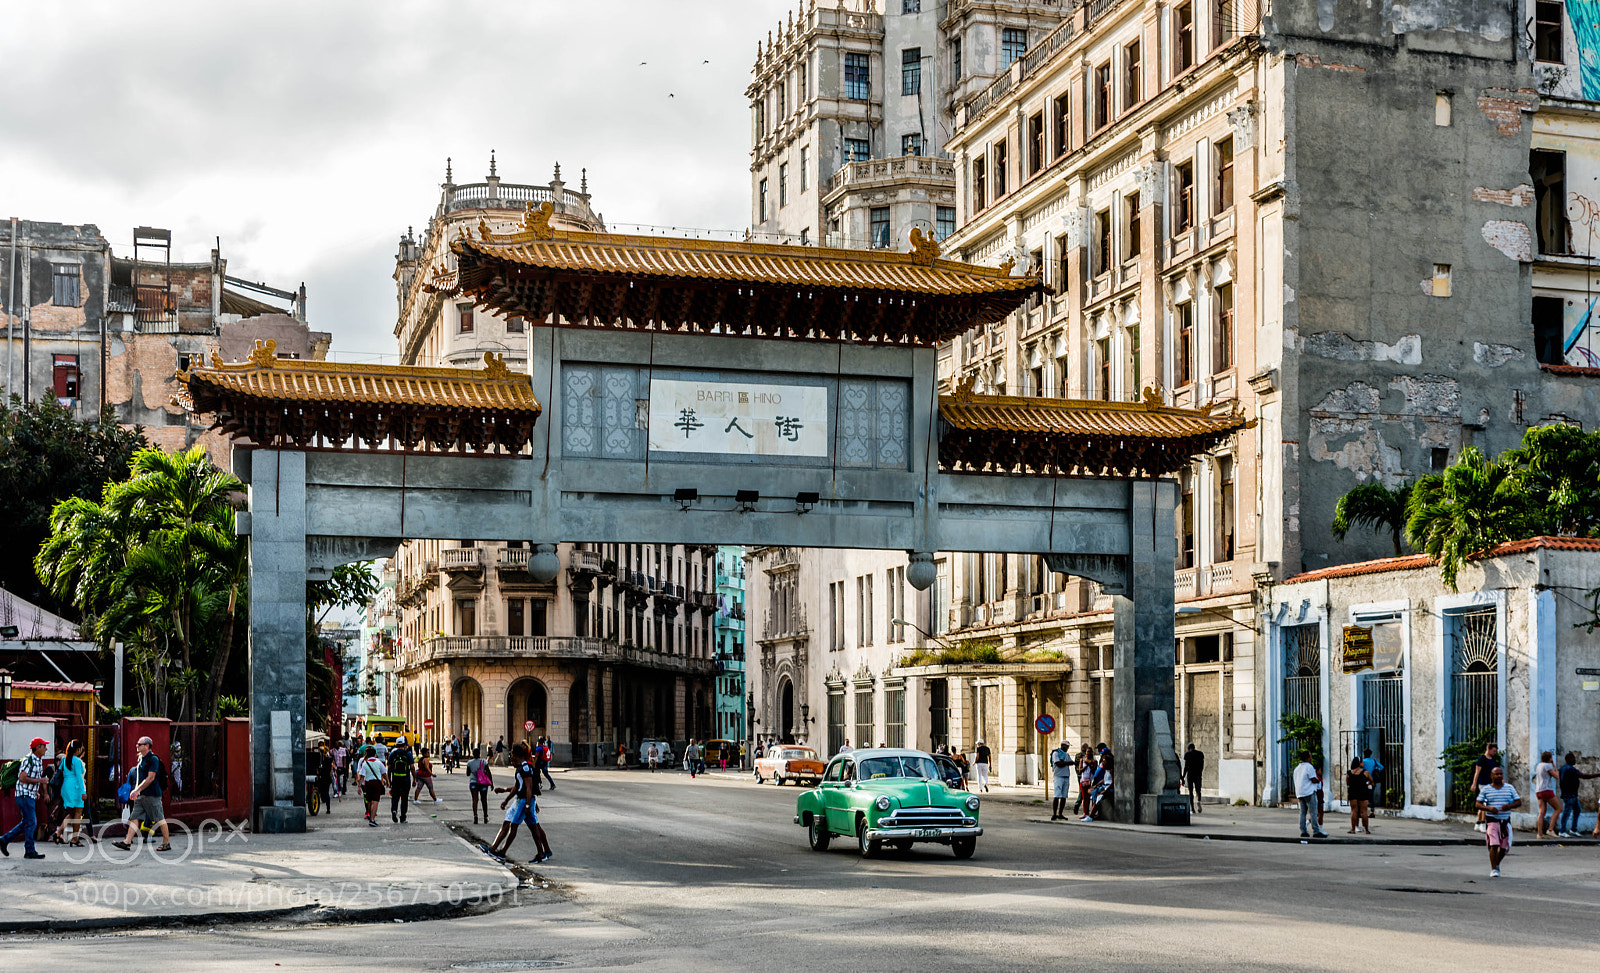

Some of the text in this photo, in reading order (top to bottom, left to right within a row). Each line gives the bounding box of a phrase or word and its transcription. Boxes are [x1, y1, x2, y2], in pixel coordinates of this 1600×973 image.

[697, 390, 734, 402] BARRI
[753, 392, 782, 405] HINO
[674, 407, 804, 442] 華人街
